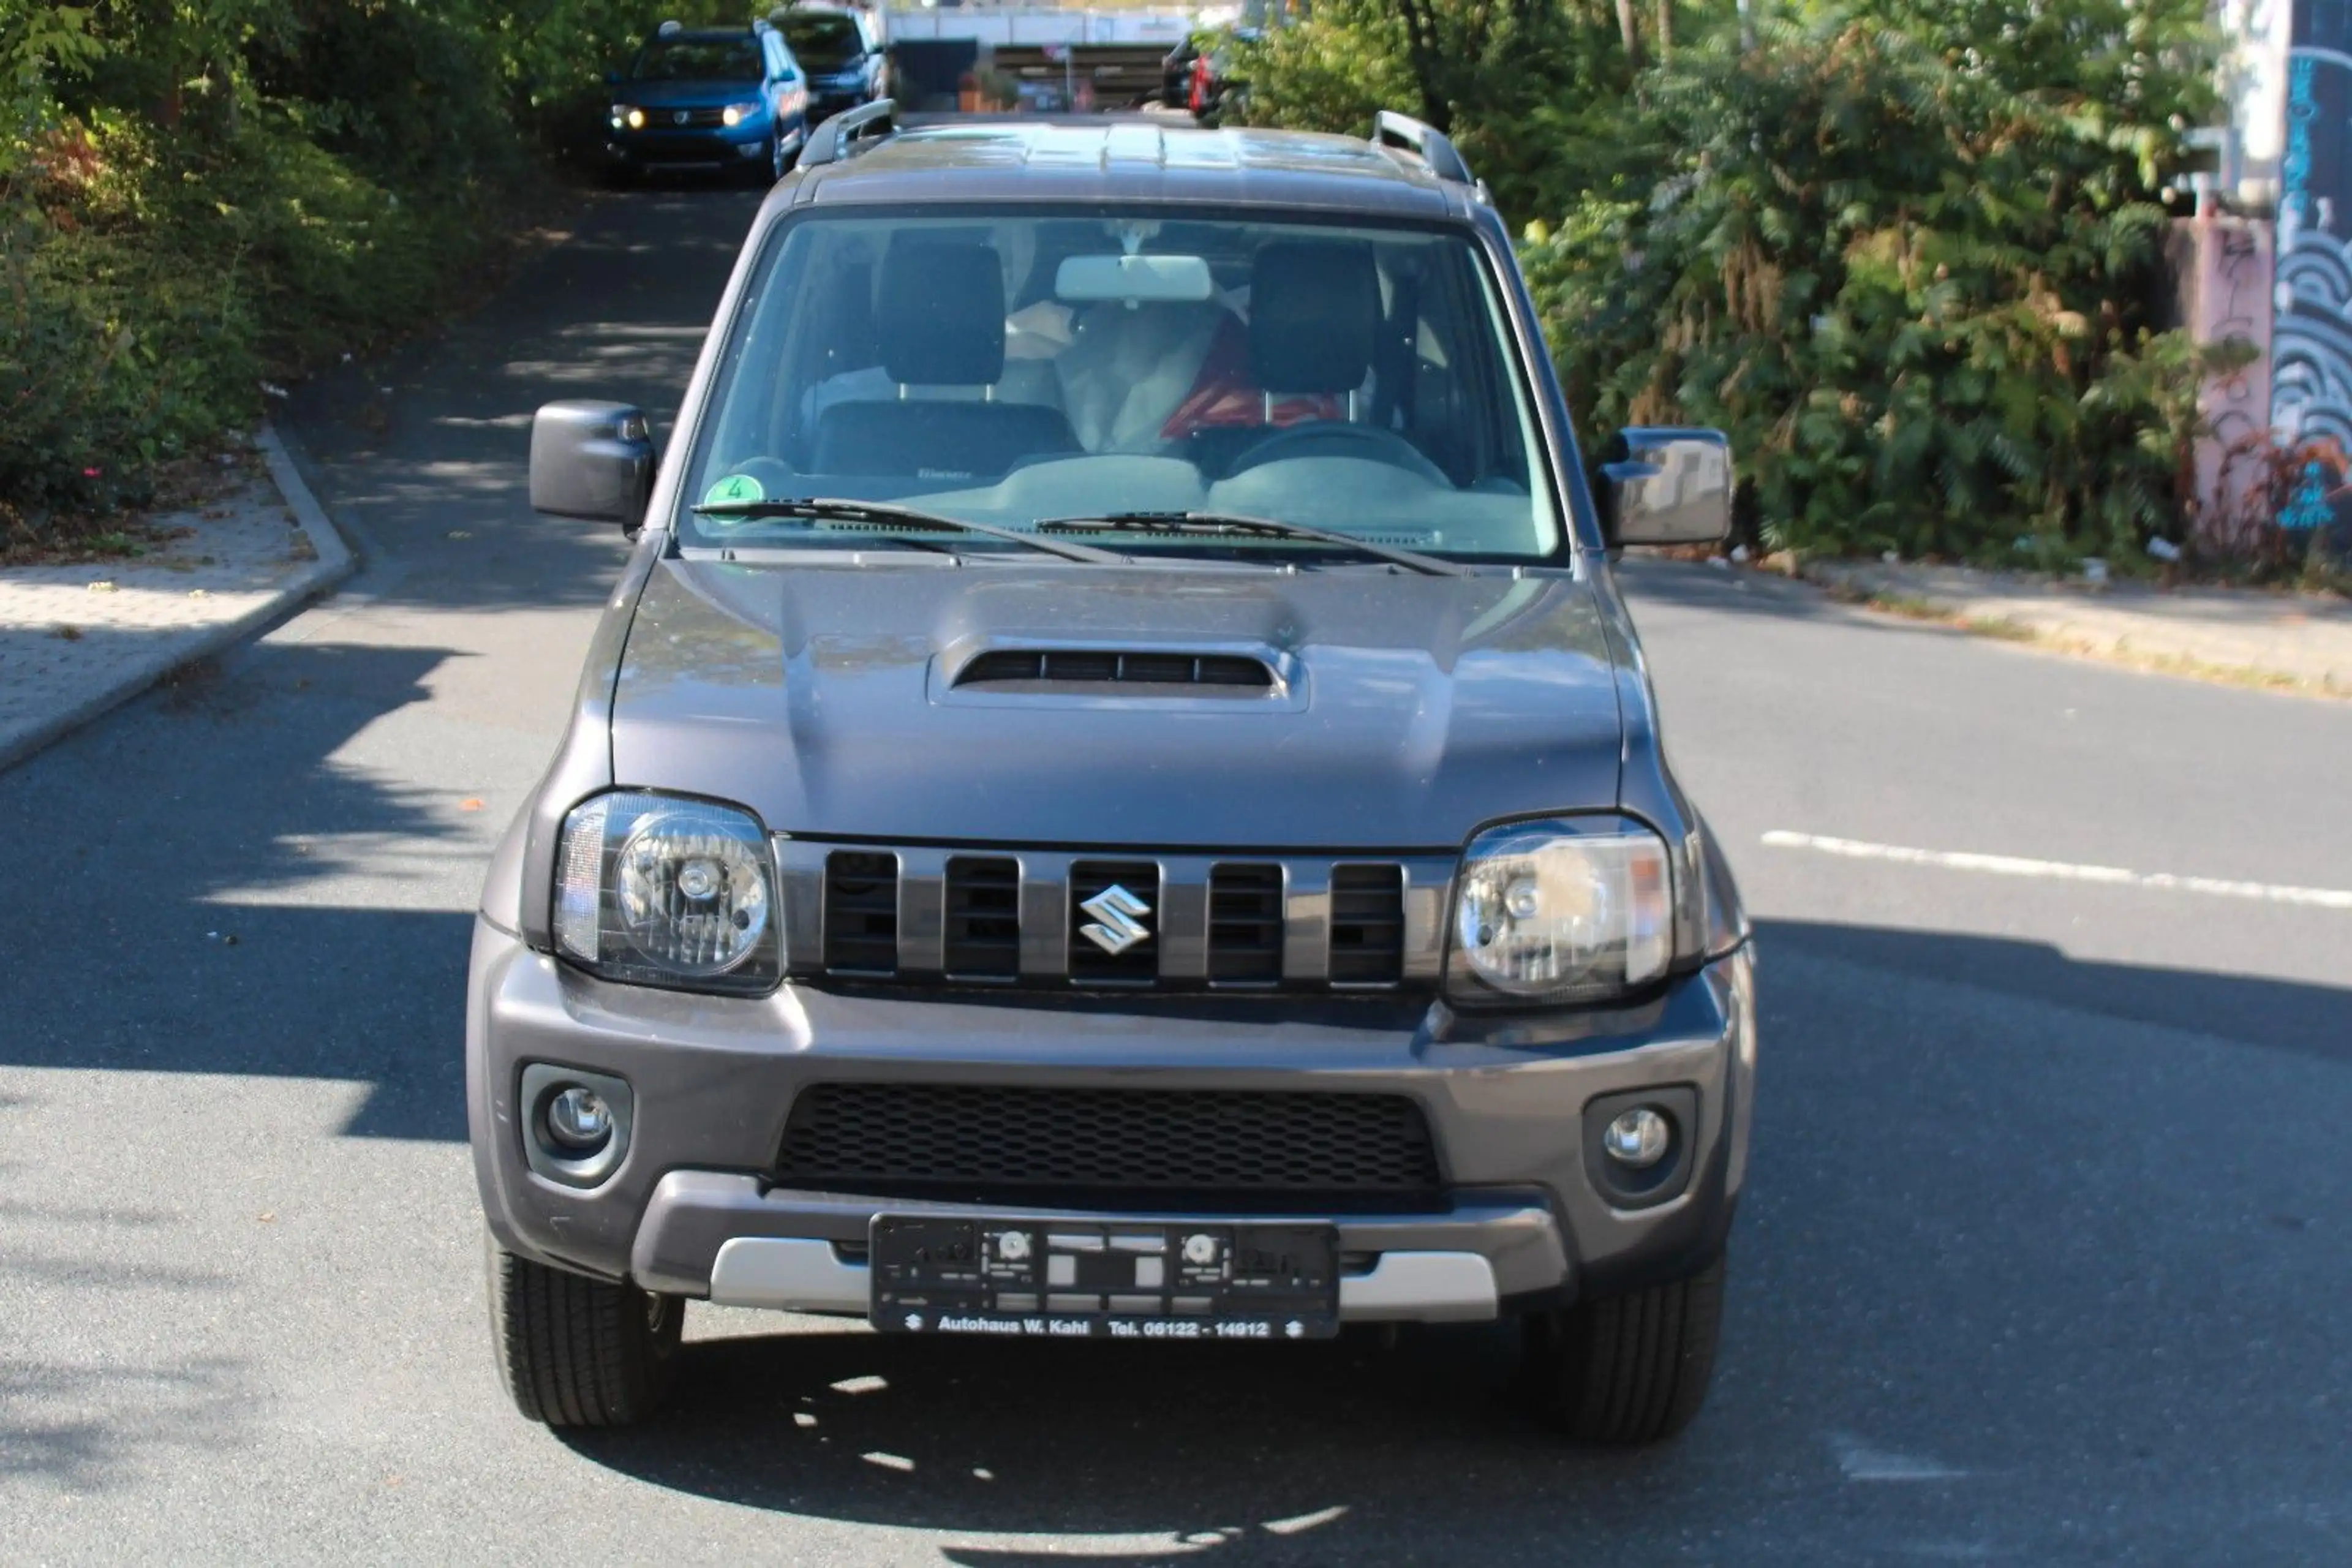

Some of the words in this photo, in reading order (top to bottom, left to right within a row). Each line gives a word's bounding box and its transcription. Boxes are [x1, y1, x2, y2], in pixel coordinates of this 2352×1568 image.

[728, 478, 742, 499] 4
[938, 1316, 1022, 1335] Autohaus
[1023, 1318, 1046, 1335] W.
[1108, 1321, 1139, 1337] Tel.
